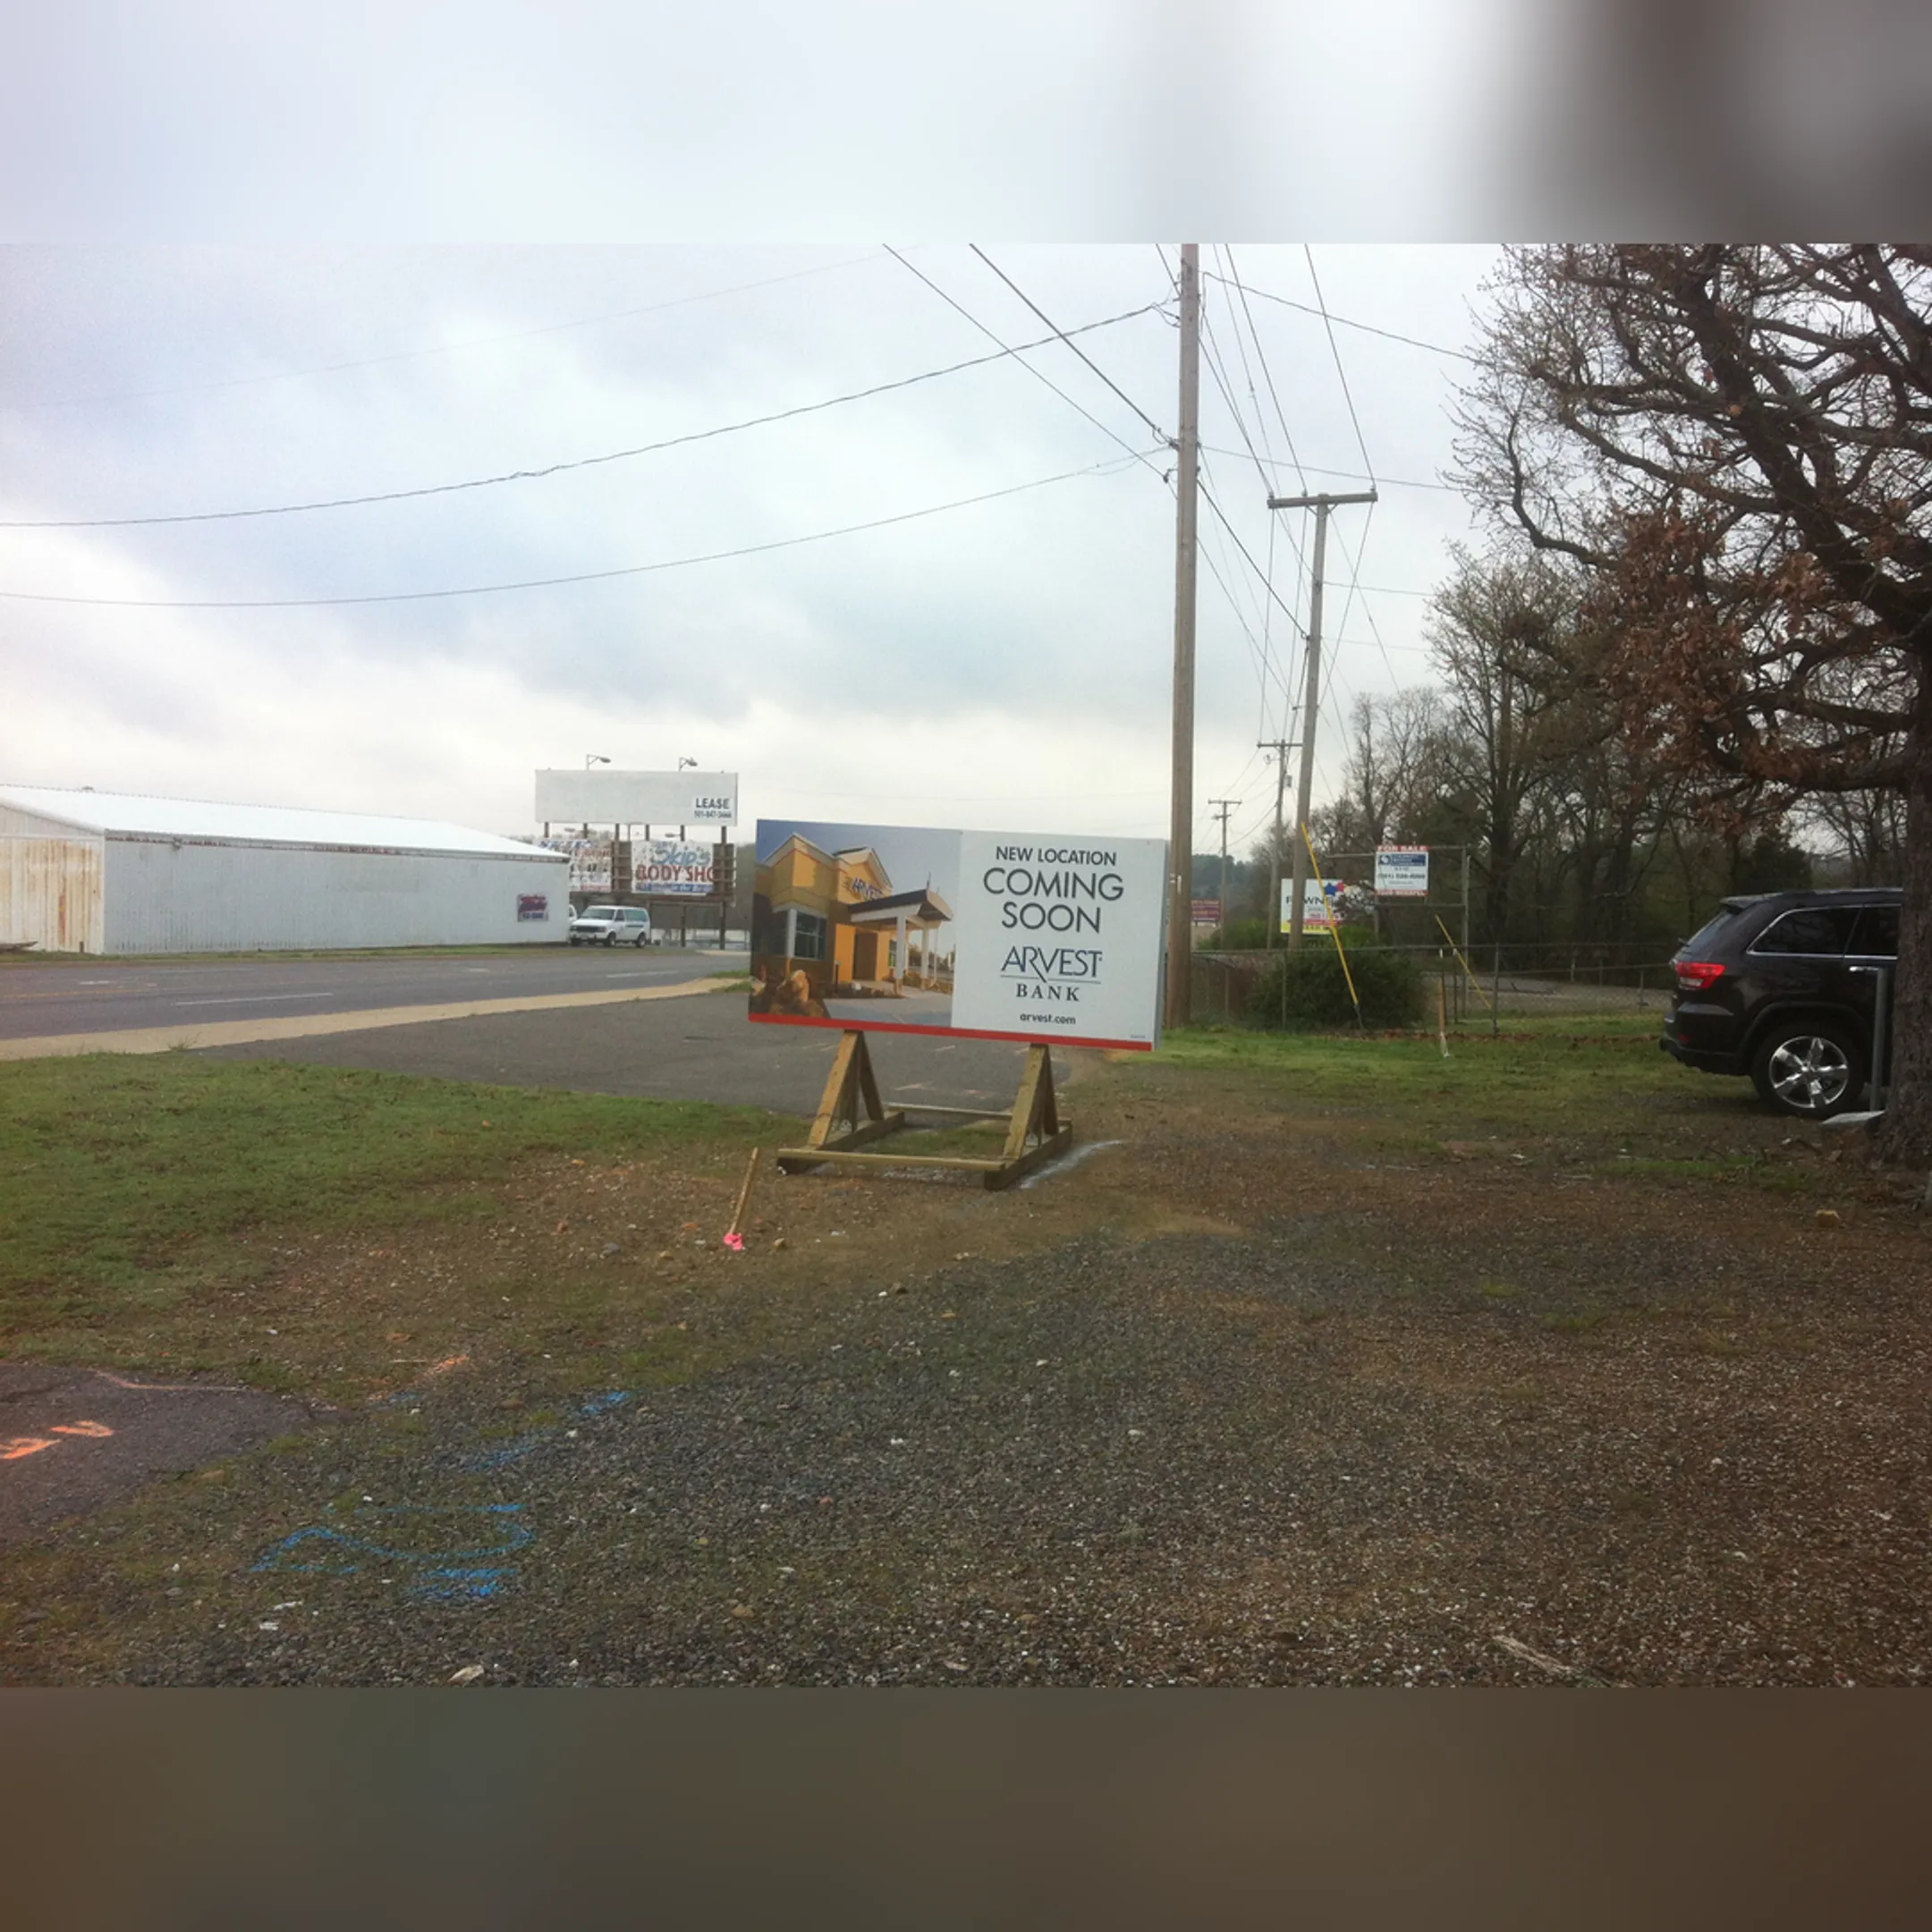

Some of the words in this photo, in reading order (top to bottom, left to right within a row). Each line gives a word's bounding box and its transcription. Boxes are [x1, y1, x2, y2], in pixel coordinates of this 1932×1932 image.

[695, 797, 731, 809] LEASE
[996, 846, 1033, 861] NEW
[1038, 849, 1116, 866] LOCATION
[635, 865, 681, 881] BODY
[983, 867, 1124, 901] COMING
[1002, 901, 1100, 933] SOON
[1001, 945, 1103, 983] ARVEST
[1015, 984, 1080, 1002] BANK
[1020, 1013, 1076, 1024] arvest.com
